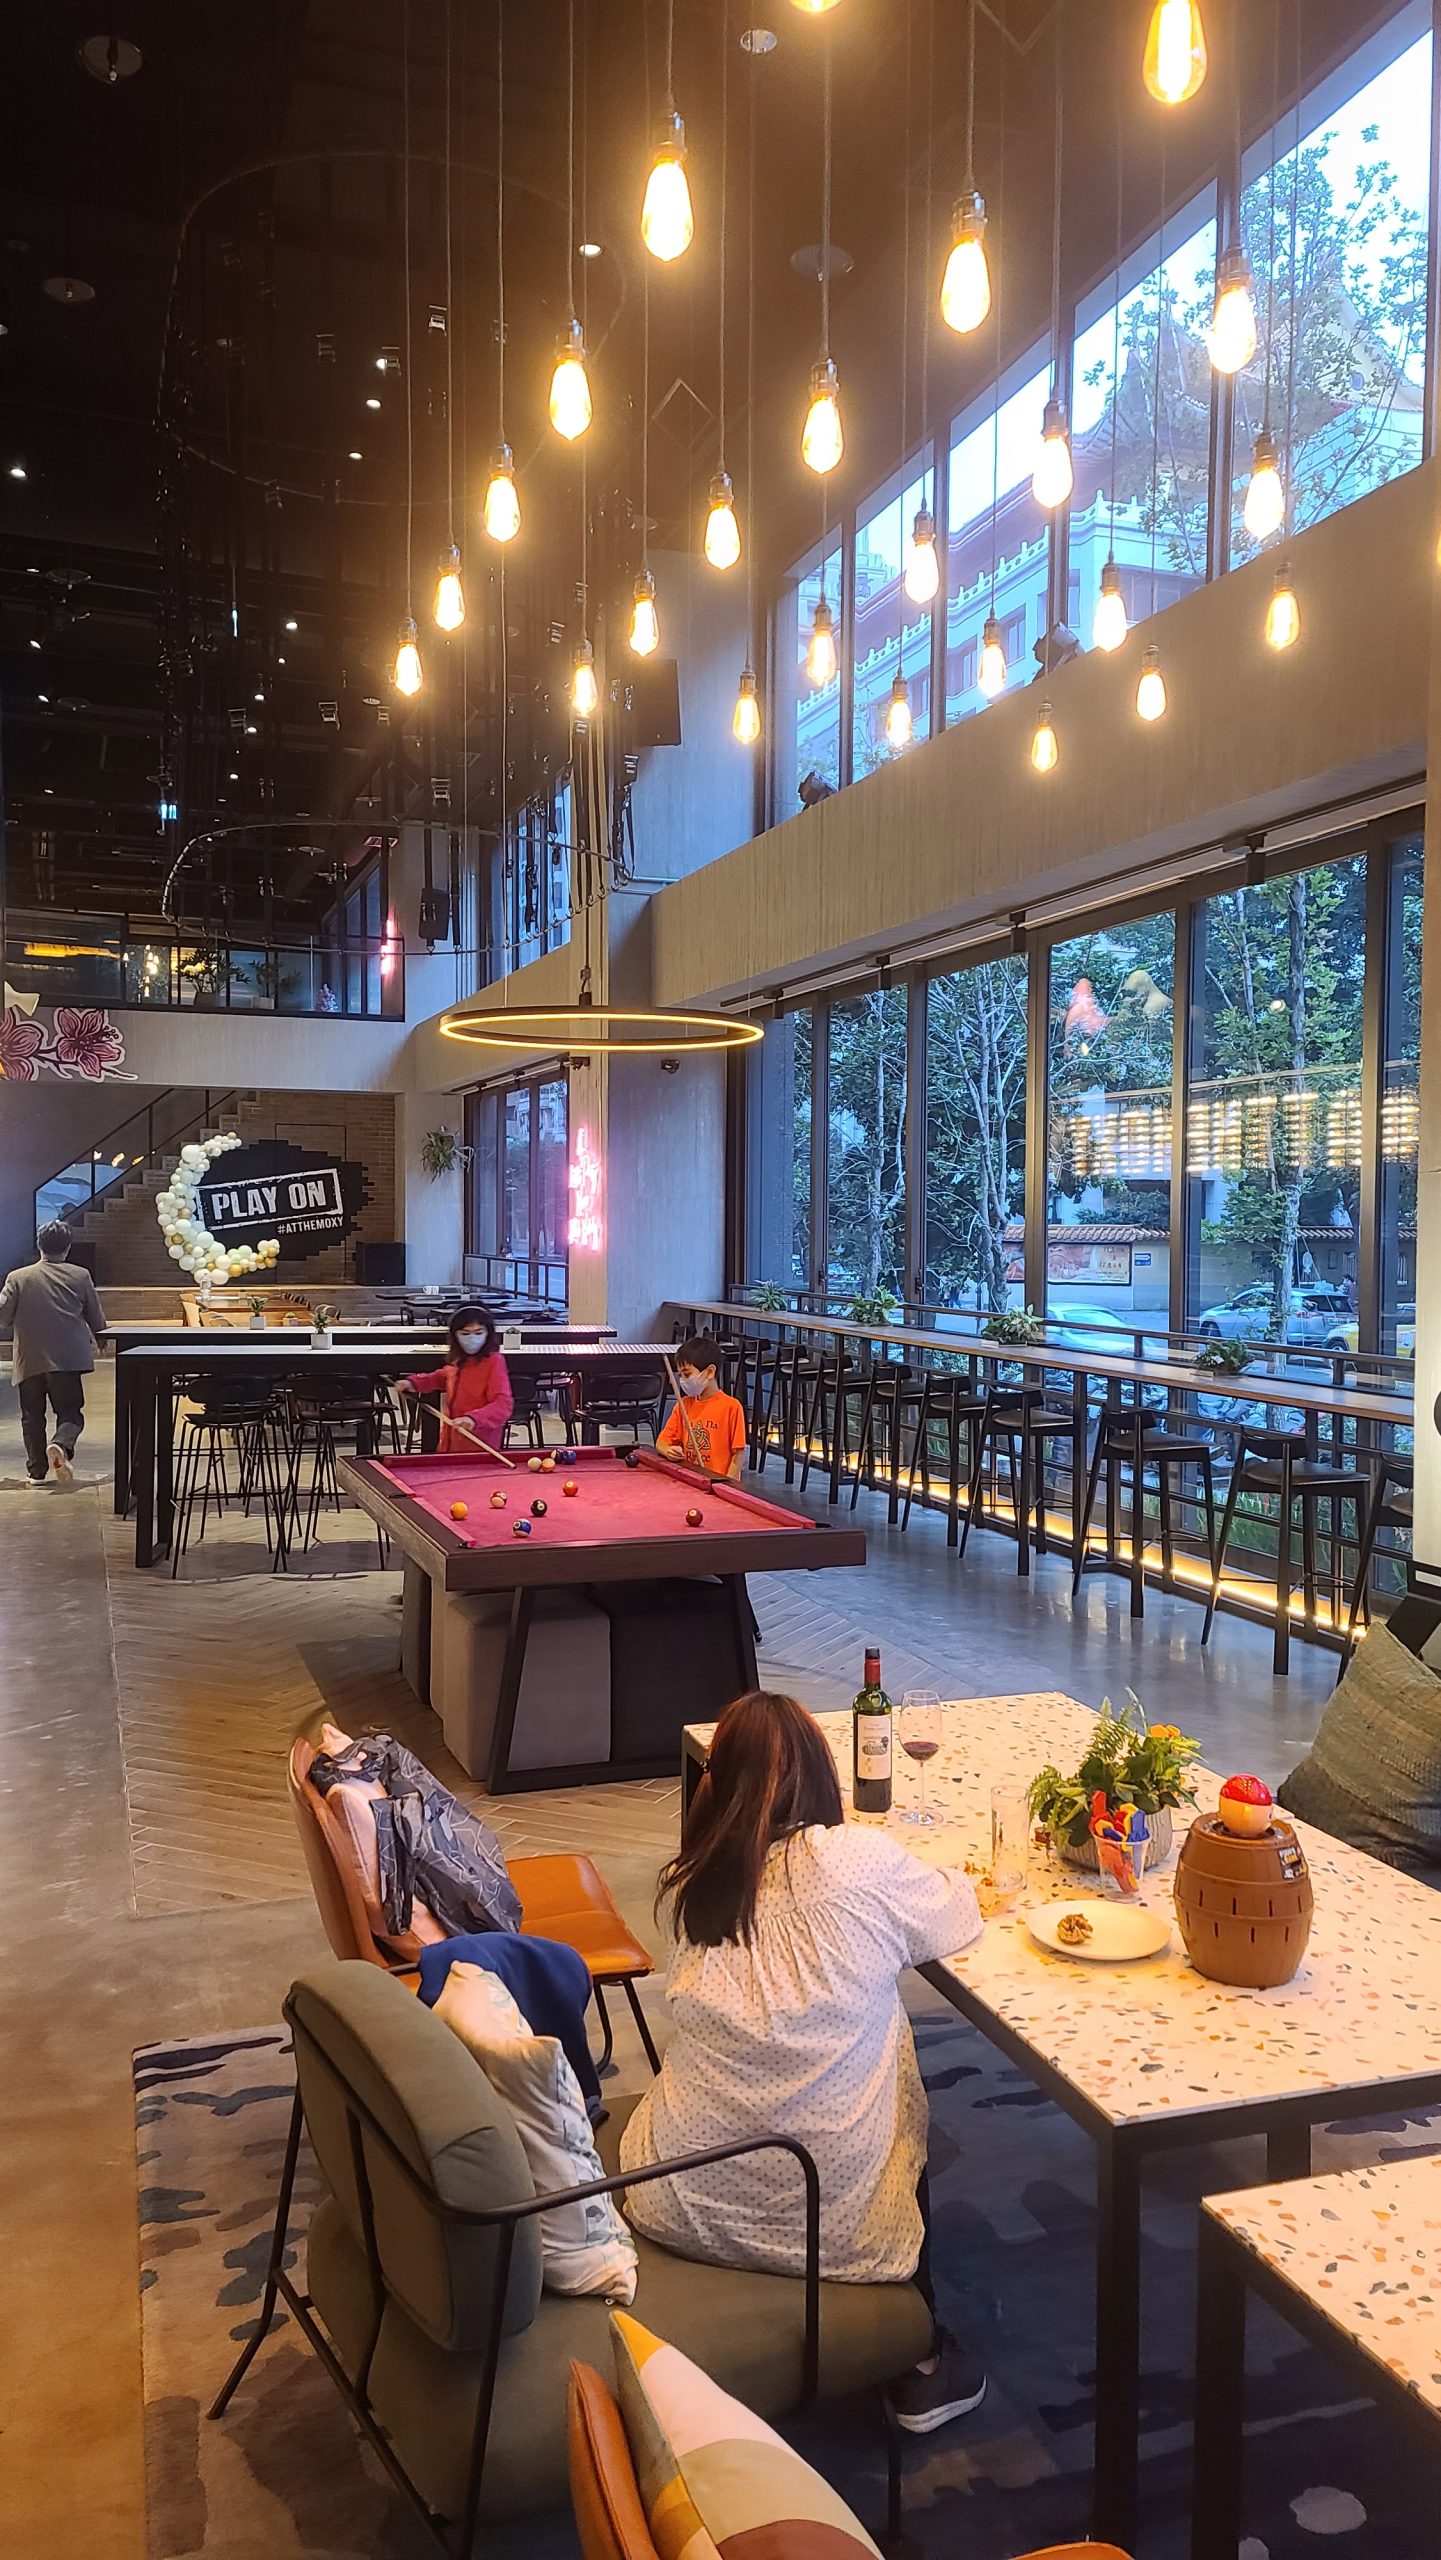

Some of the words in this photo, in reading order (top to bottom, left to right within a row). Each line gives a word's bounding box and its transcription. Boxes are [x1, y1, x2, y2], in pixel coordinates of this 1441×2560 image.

[211, 1186, 277, 1220] PLAY
[288, 1180, 327, 1210] ON
[277, 1216, 344, 1234] #ATTHEMOXY
